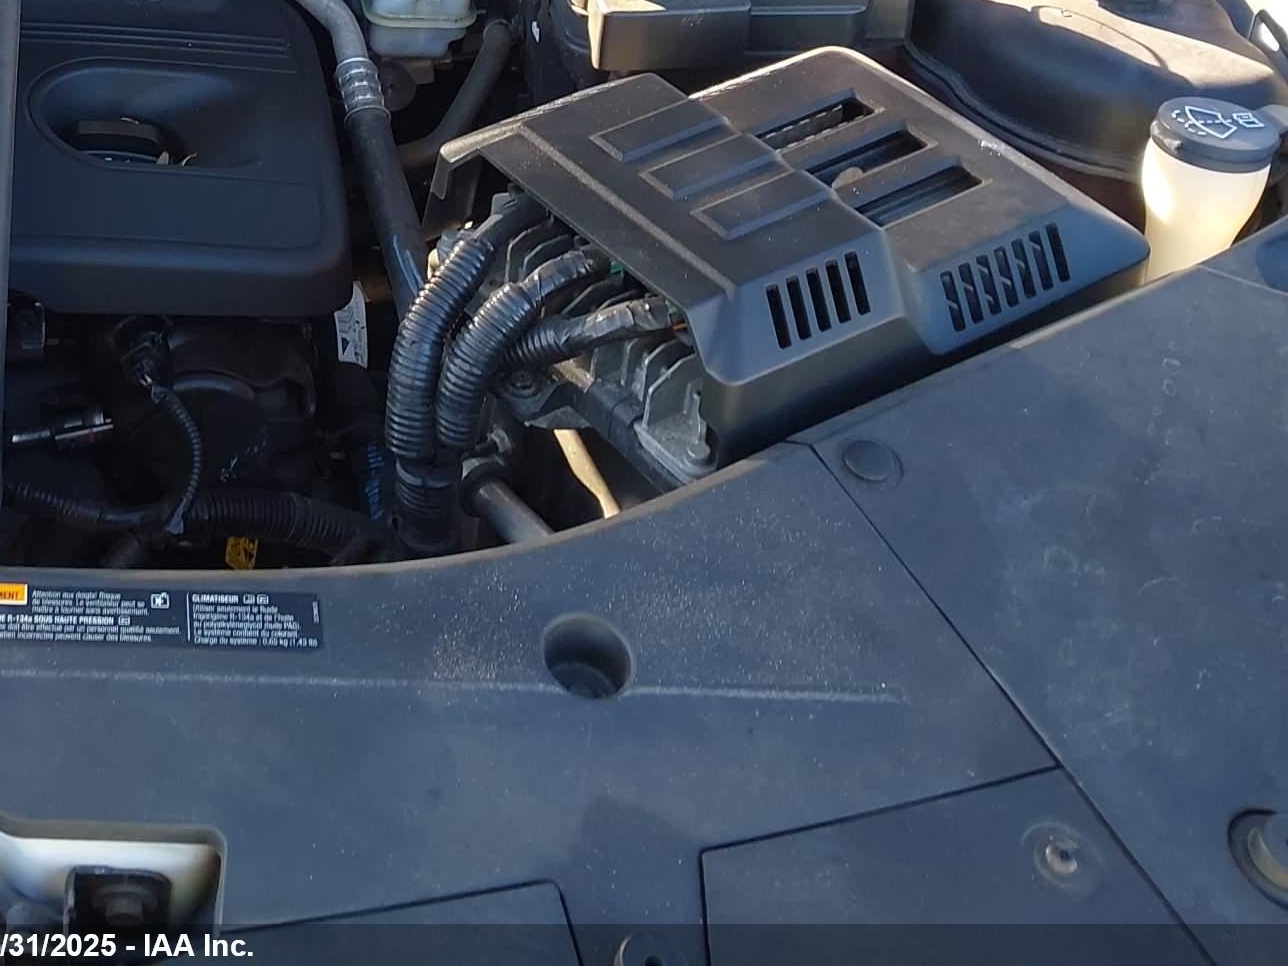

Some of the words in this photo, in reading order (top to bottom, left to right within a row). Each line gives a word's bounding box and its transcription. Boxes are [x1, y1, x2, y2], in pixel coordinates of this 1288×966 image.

[192, 594, 239, 604] CLIMATISEUR
[8, 614, 32, 623] R-134a
[34, 615, 53, 624] SOUS
[55, 615, 77, 624] HAUTE
[79, 616, 114, 625] PRESSION
